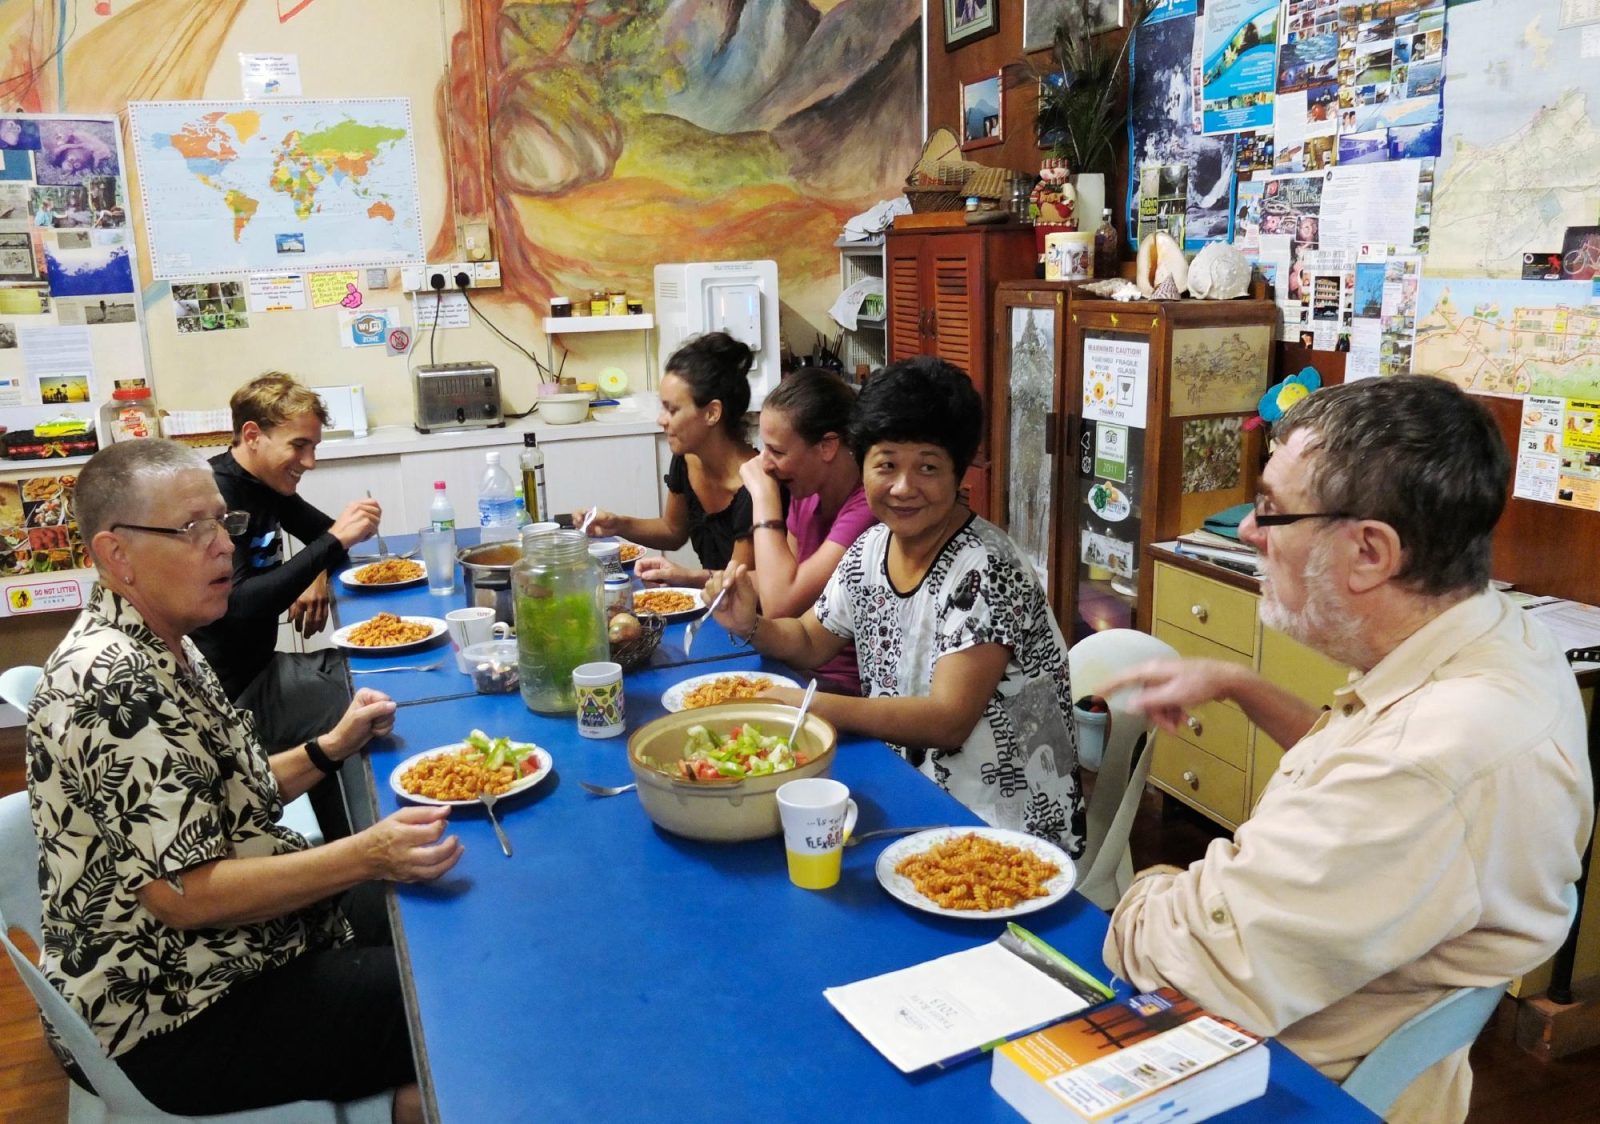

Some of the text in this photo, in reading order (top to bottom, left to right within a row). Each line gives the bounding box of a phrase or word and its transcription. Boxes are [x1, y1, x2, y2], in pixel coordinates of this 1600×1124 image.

[1115, 346, 1142, 355] CAUTION!
[1115, 358, 1138, 367] FRAGILE
[1117, 367, 1136, 375] GLASS
[1099, 408, 1125, 418] THANK YOU
[1548, 418, 1558, 426] 45
[1528, 441, 1537, 450] 28
[1102, 463, 1117, 474] 2011
[57, 586, 76, 594] LITTER
